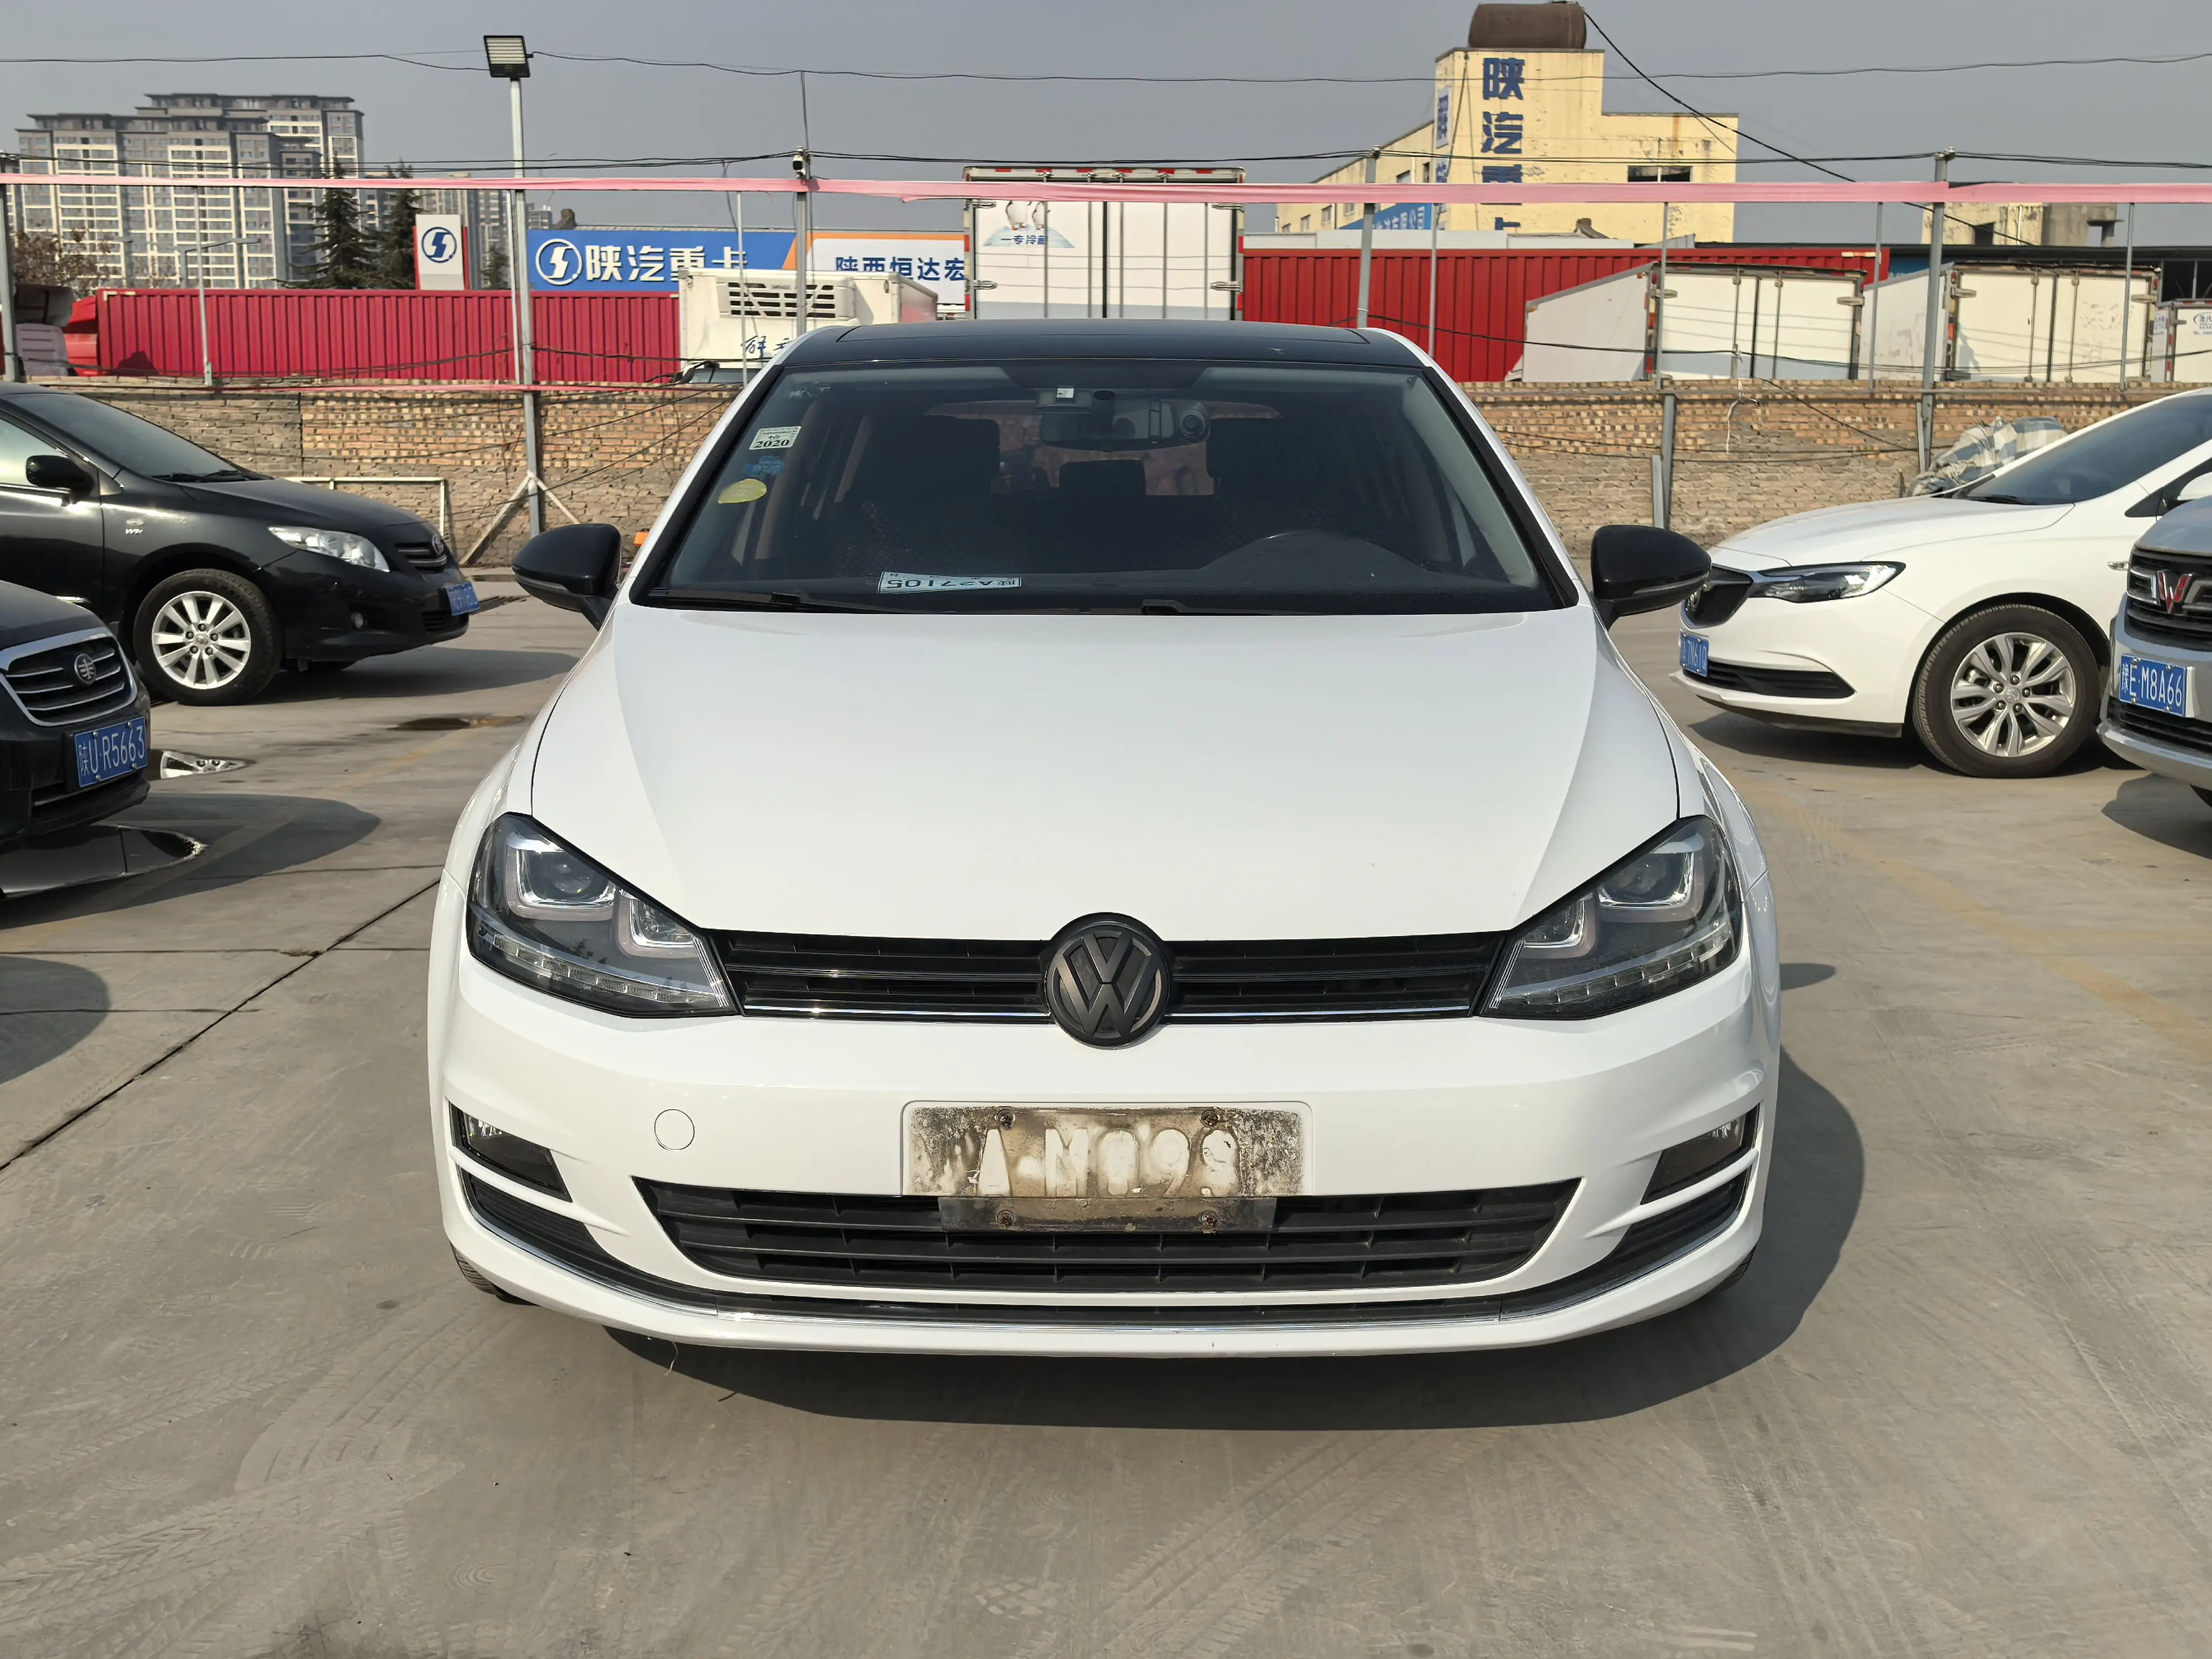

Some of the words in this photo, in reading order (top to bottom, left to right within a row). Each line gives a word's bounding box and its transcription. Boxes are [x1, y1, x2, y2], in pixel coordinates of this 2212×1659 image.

[585, 245, 747, 281] 陕汽重卡
[835, 257, 965, 281] 陕西恒达宏
[753, 440, 790, 448] 2020
[78, 725, 145, 778] 陕U·R5663
